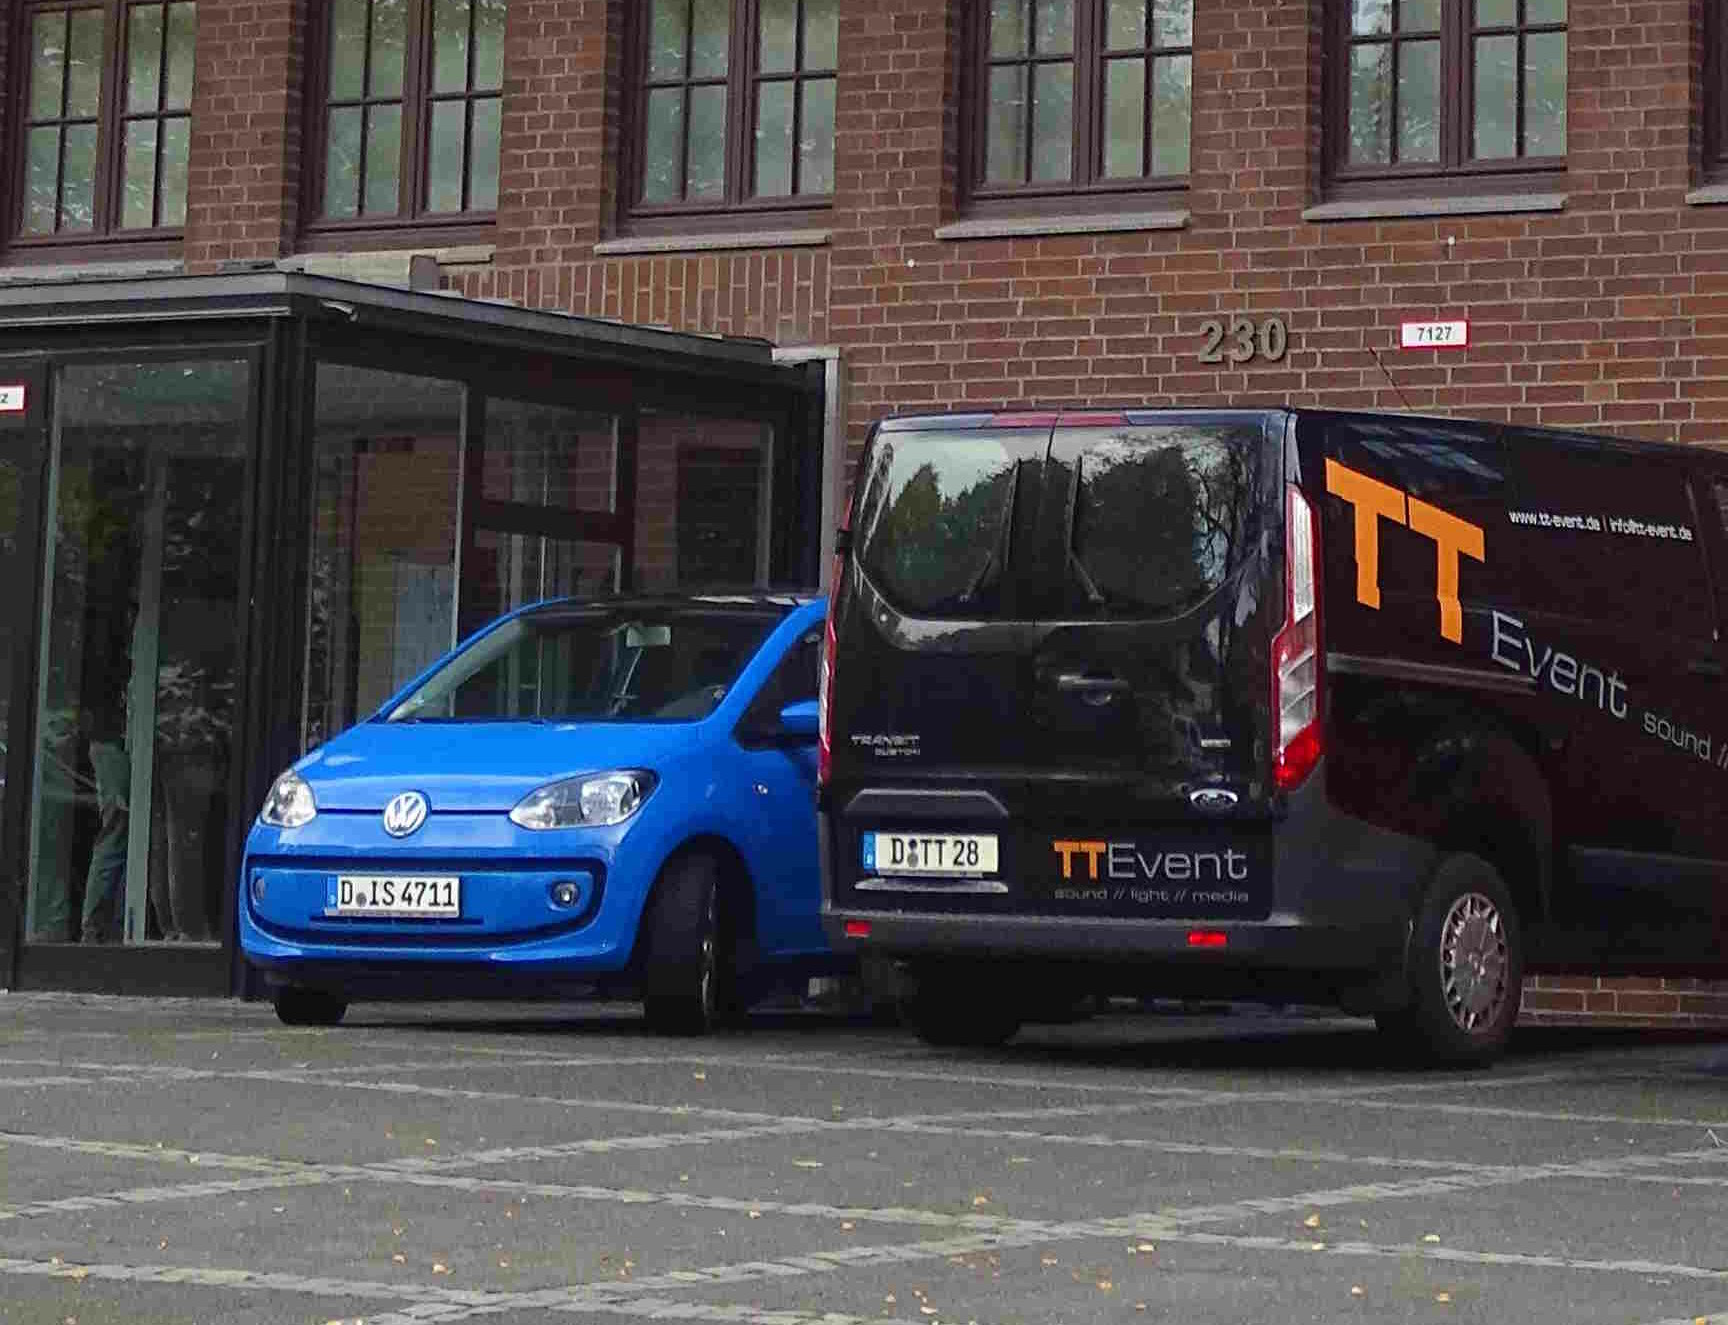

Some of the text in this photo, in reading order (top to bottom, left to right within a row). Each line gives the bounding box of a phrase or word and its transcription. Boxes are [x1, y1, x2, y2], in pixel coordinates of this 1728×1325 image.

[1197, 317, 1288, 364] 230
[1416, 326, 1453, 342] 7127
[1325, 457, 1486, 645] TT
[1491, 610, 1629, 718] Event
[1642, 710, 1713, 761] sound
[400, 881, 455, 907] 4711
[1054, 888, 1108, 900] sound
[1130, 887, 1169, 903] light
[1191, 889, 1249, 903] media
